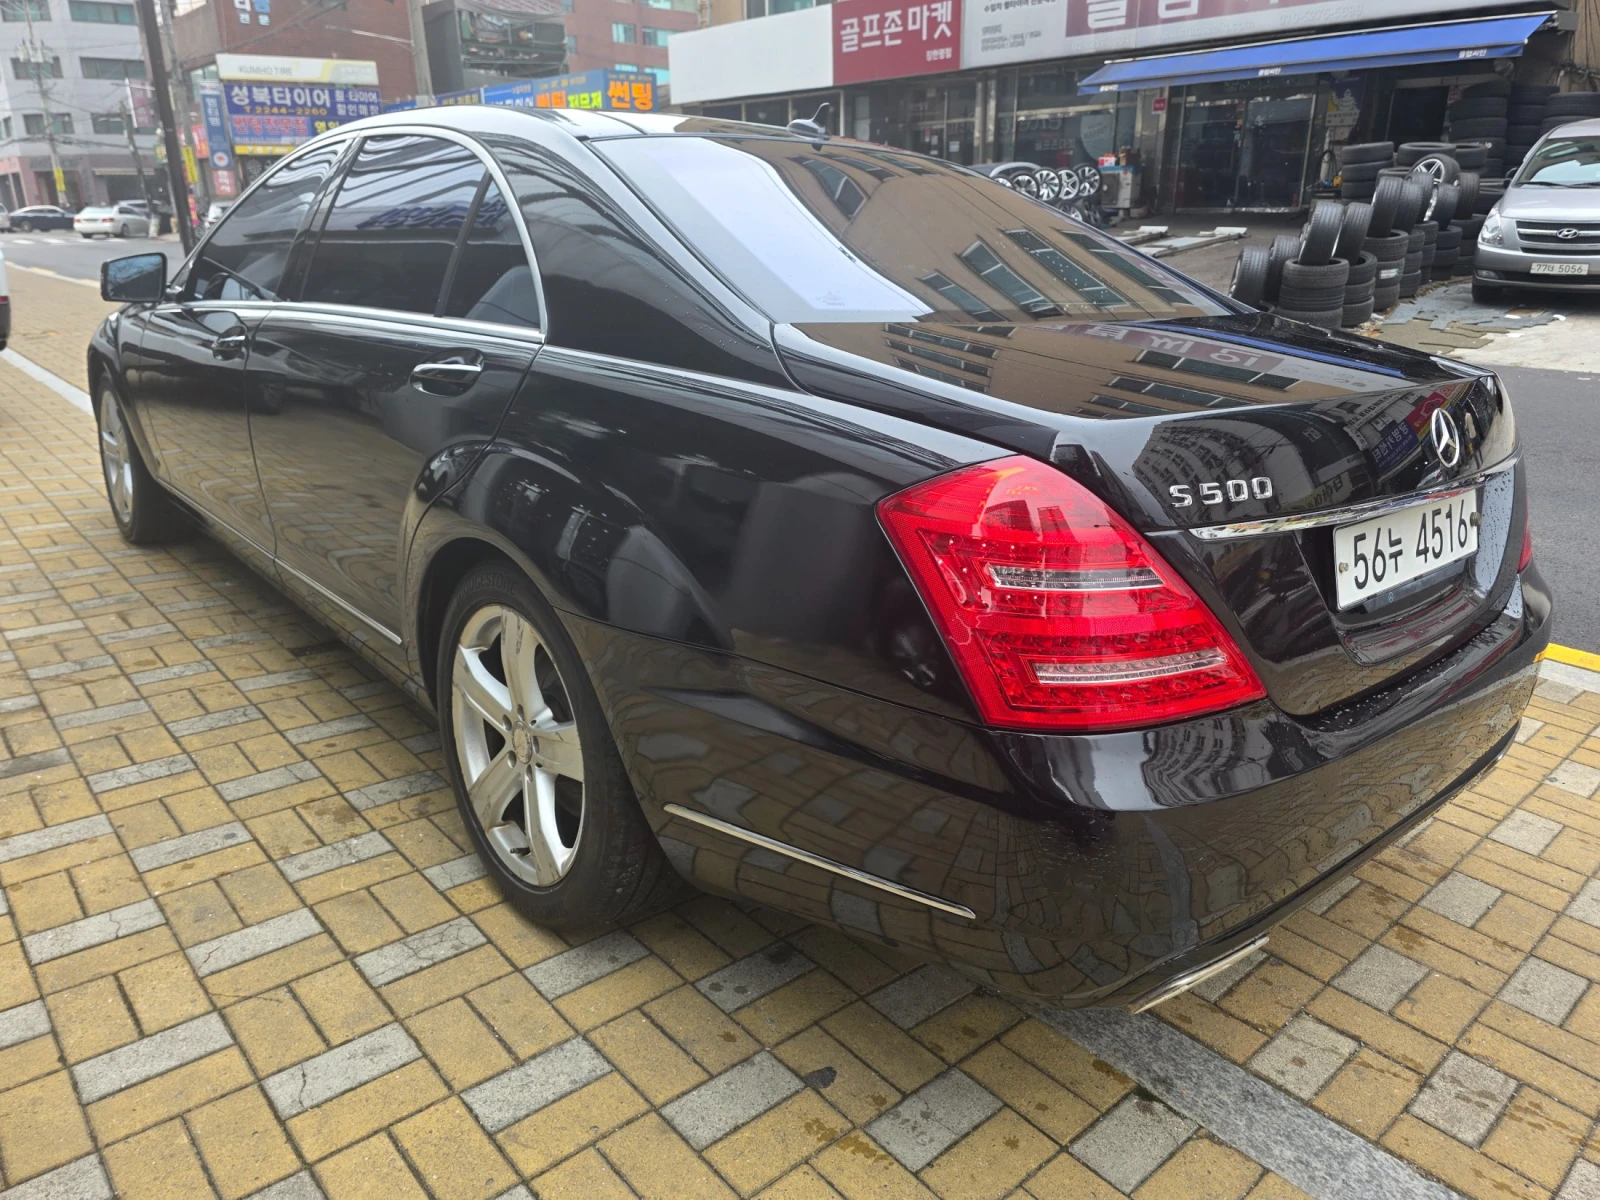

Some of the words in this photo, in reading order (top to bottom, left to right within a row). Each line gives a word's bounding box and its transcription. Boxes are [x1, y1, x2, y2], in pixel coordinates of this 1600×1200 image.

[840, 1, 952, 53] 골프존마켓
[926, 48, 953, 61] 장한평점
[274, 67, 293, 76] TIRE
[231, 86, 331, 107] 성북타이어
[607, 80, 652, 110] 썬팅
[1558, 264, 1583, 274] 5056
[1169, 485, 1191, 508] S
[1199, 477, 1273, 506] 500
[1353, 527, 1405, 590] 56누
[1414, 500, 1469, 565] 4516
